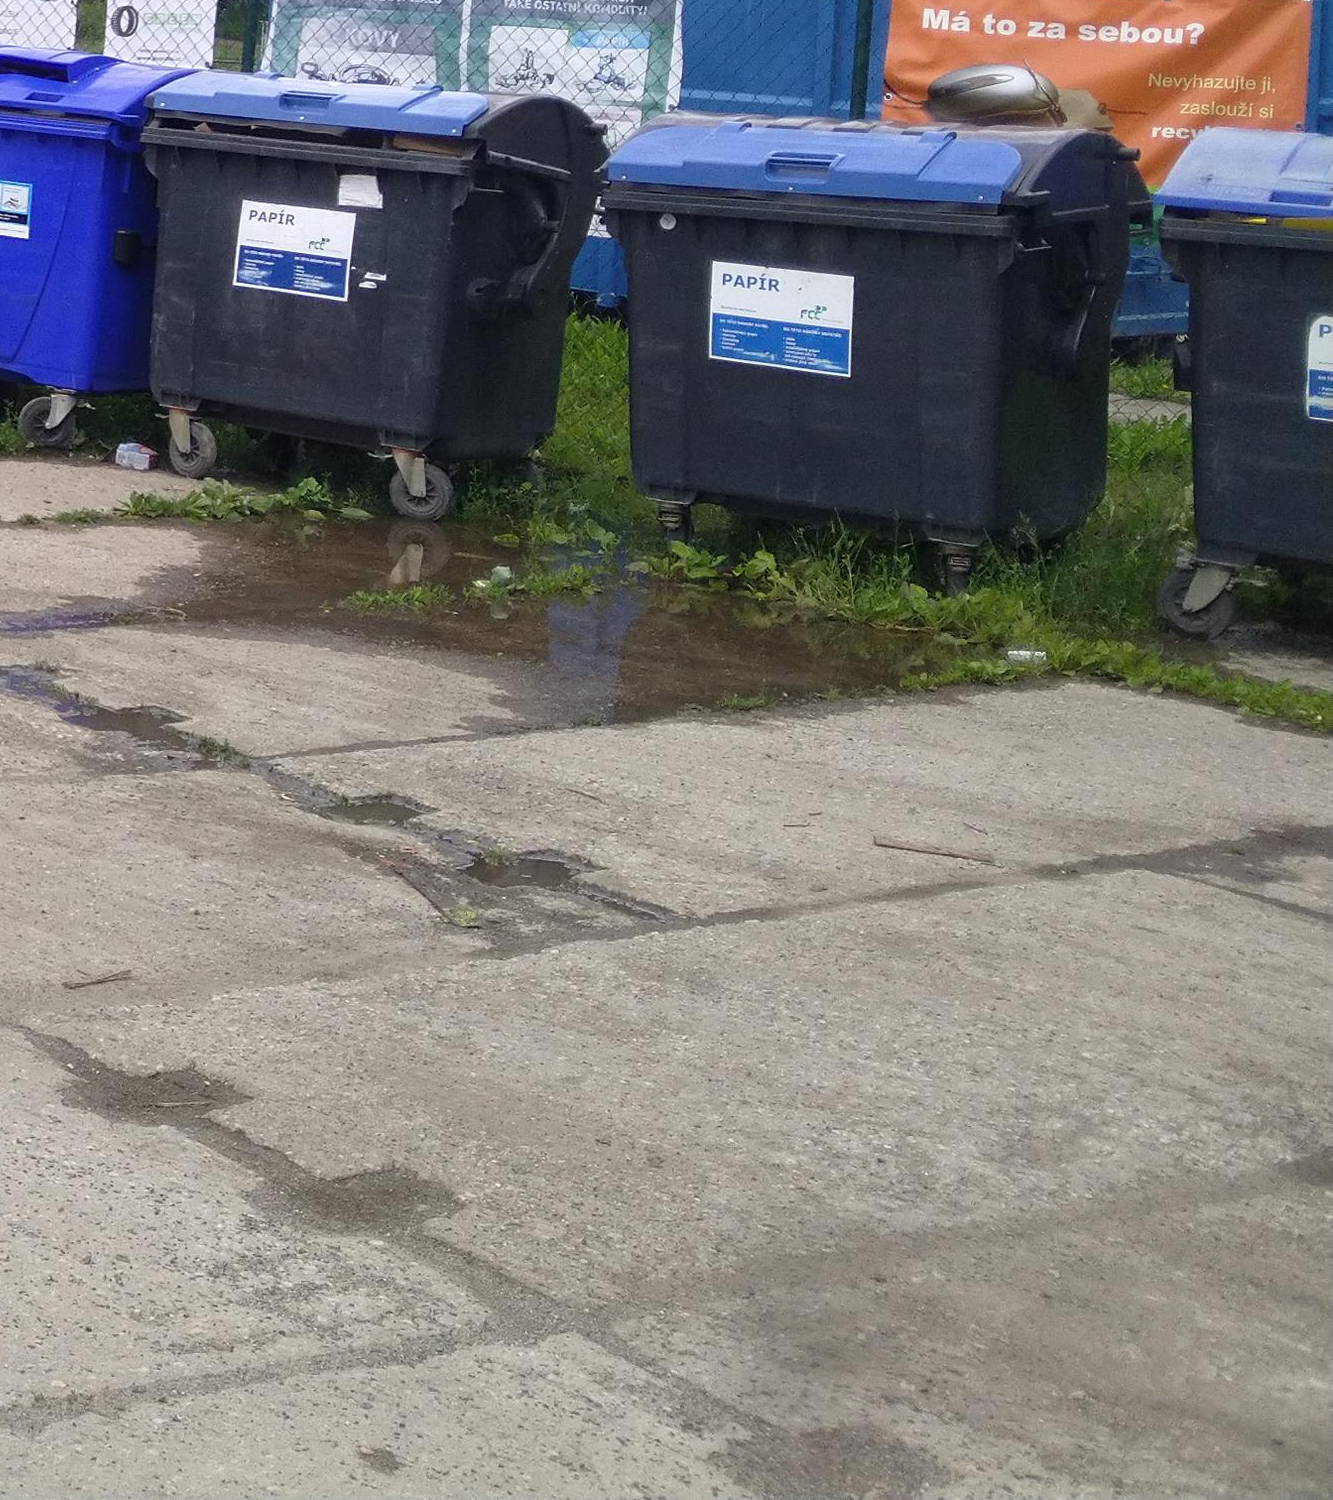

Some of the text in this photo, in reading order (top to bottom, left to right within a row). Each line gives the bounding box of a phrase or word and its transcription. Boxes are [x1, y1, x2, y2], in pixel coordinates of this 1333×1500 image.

[922, 8, 1205, 45] Má to za sebou?
[1148, 73, 1276, 94] Nevyhazujte ji,
[1180, 101, 1274, 119] zaslouží si
[248, 209, 295, 226] PAPÍR
[722, 273, 780, 292] PAPÍR
